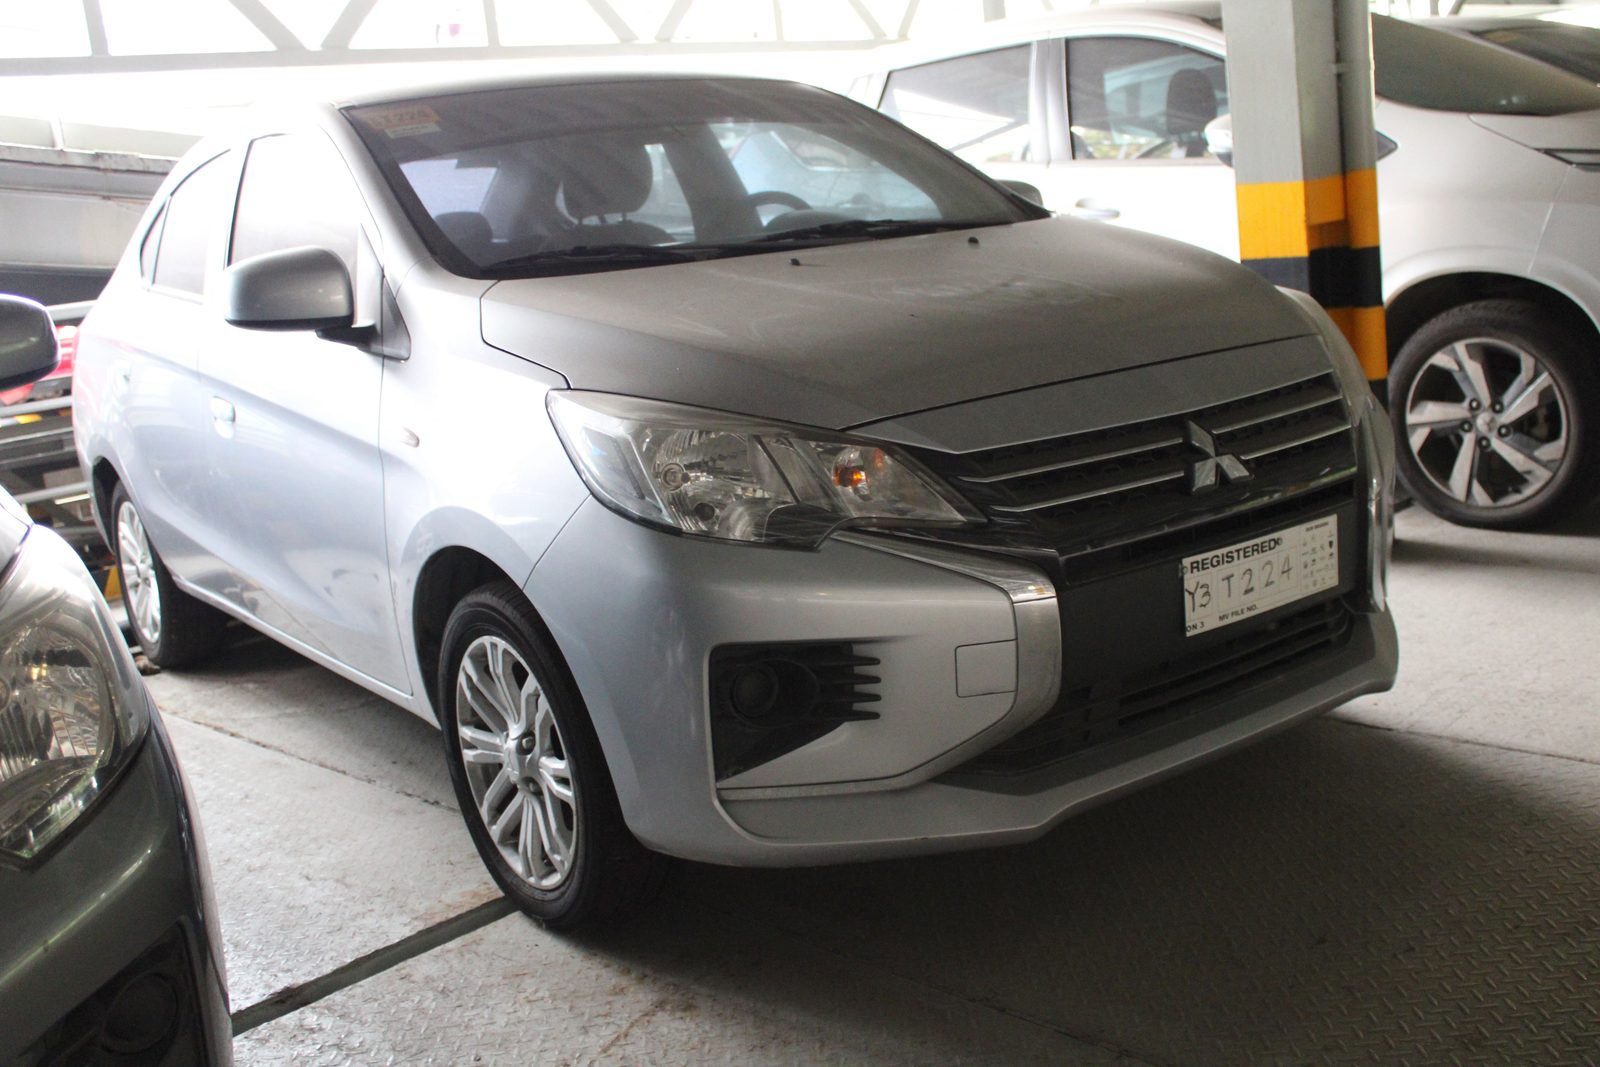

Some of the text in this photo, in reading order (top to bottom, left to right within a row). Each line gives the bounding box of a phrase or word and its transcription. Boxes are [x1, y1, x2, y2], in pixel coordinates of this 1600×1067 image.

[1190, 538, 1276, 574] REGISTERED
[1185, 581, 1211, 613] Y3
[1218, 613, 1230, 622] MV
[1231, 608, 1245, 618] FILE
